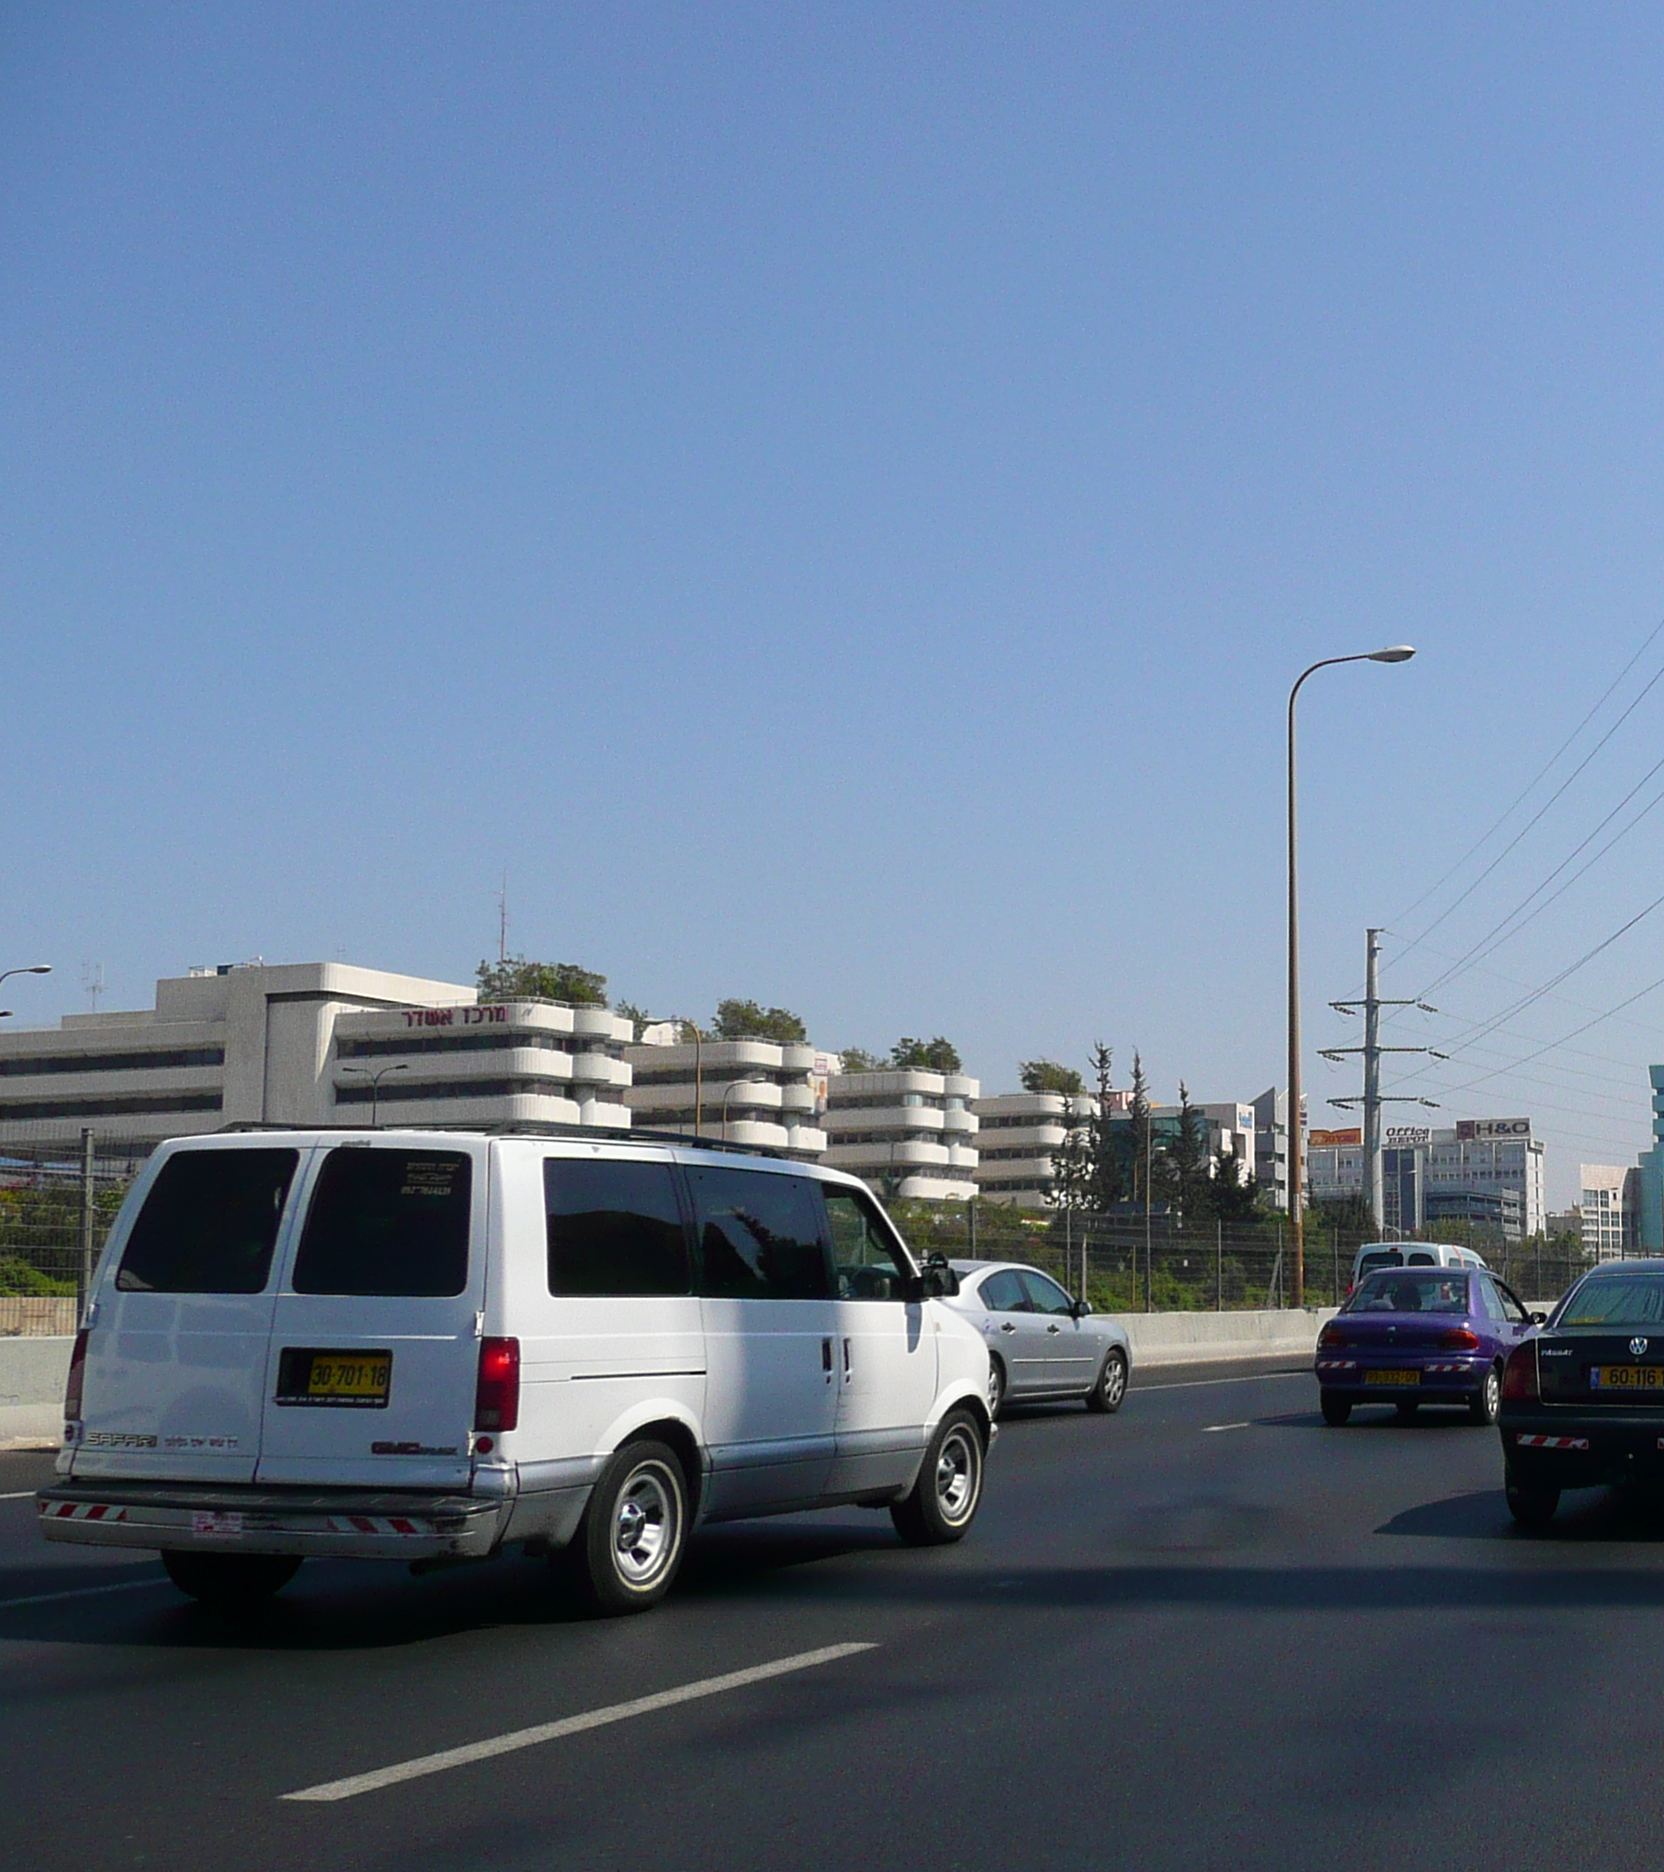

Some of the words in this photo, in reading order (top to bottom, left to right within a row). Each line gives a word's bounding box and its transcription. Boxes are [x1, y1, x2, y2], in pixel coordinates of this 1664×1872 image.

[401, 1009, 454, 1028] אשדר
[462, 1006, 509, 1024] מרכז
[1386, 1126, 1430, 1137] Office
[1476, 1121, 1530, 1135] H&O
[87, 1433, 158, 1448] SAFARI
